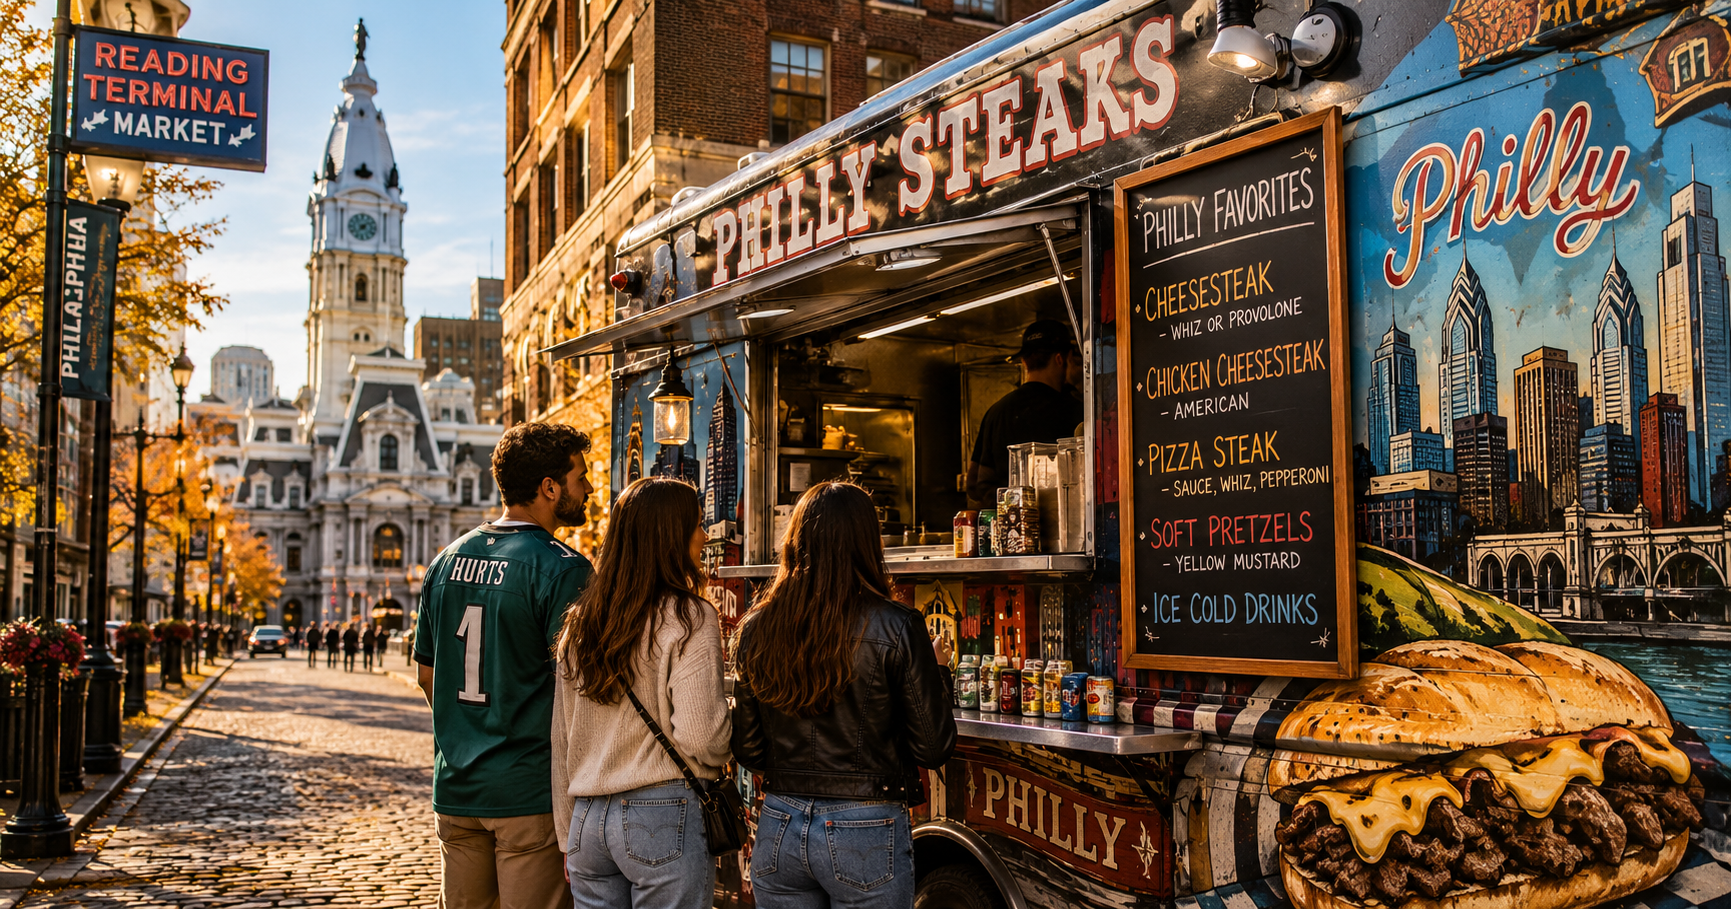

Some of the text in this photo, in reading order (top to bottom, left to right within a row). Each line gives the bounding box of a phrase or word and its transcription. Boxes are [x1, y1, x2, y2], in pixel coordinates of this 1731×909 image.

[95, 41, 248, 84] READING
[83, 73, 257, 119] TERMINAL
[113, 110, 226, 146] MARKET
[712, 14, 1180, 286] PHILLY STEAKS
[1143, 167, 1314, 253] PHILLY FAVORITES
[1383, 101, 1640, 289] Philly
[1145, 260, 1274, 322] CHEESESTEAK
[1171, 296, 1303, 340] WHIZ OR PROVOLONE
[1147, 338, 1326, 399] CHICKEN CHEESESTEAK
[1174, 391, 1249, 420] AMERICAN
[1148, 430, 1280, 476] PIZZA STEAK
[1173, 465, 1330, 497] SAUCE, WHIZ, PEPPERONI
[1150, 510, 1313, 549] SOFT PRETZELS
[450, 556, 509, 586] HURTS
[1175, 551, 1301, 574] YELLOW MUSTARD
[1153, 592, 1319, 626] ICE COLD DRINKS
[456, 603, 490, 706] 1
[982, 766, 1127, 870] PHILLY
